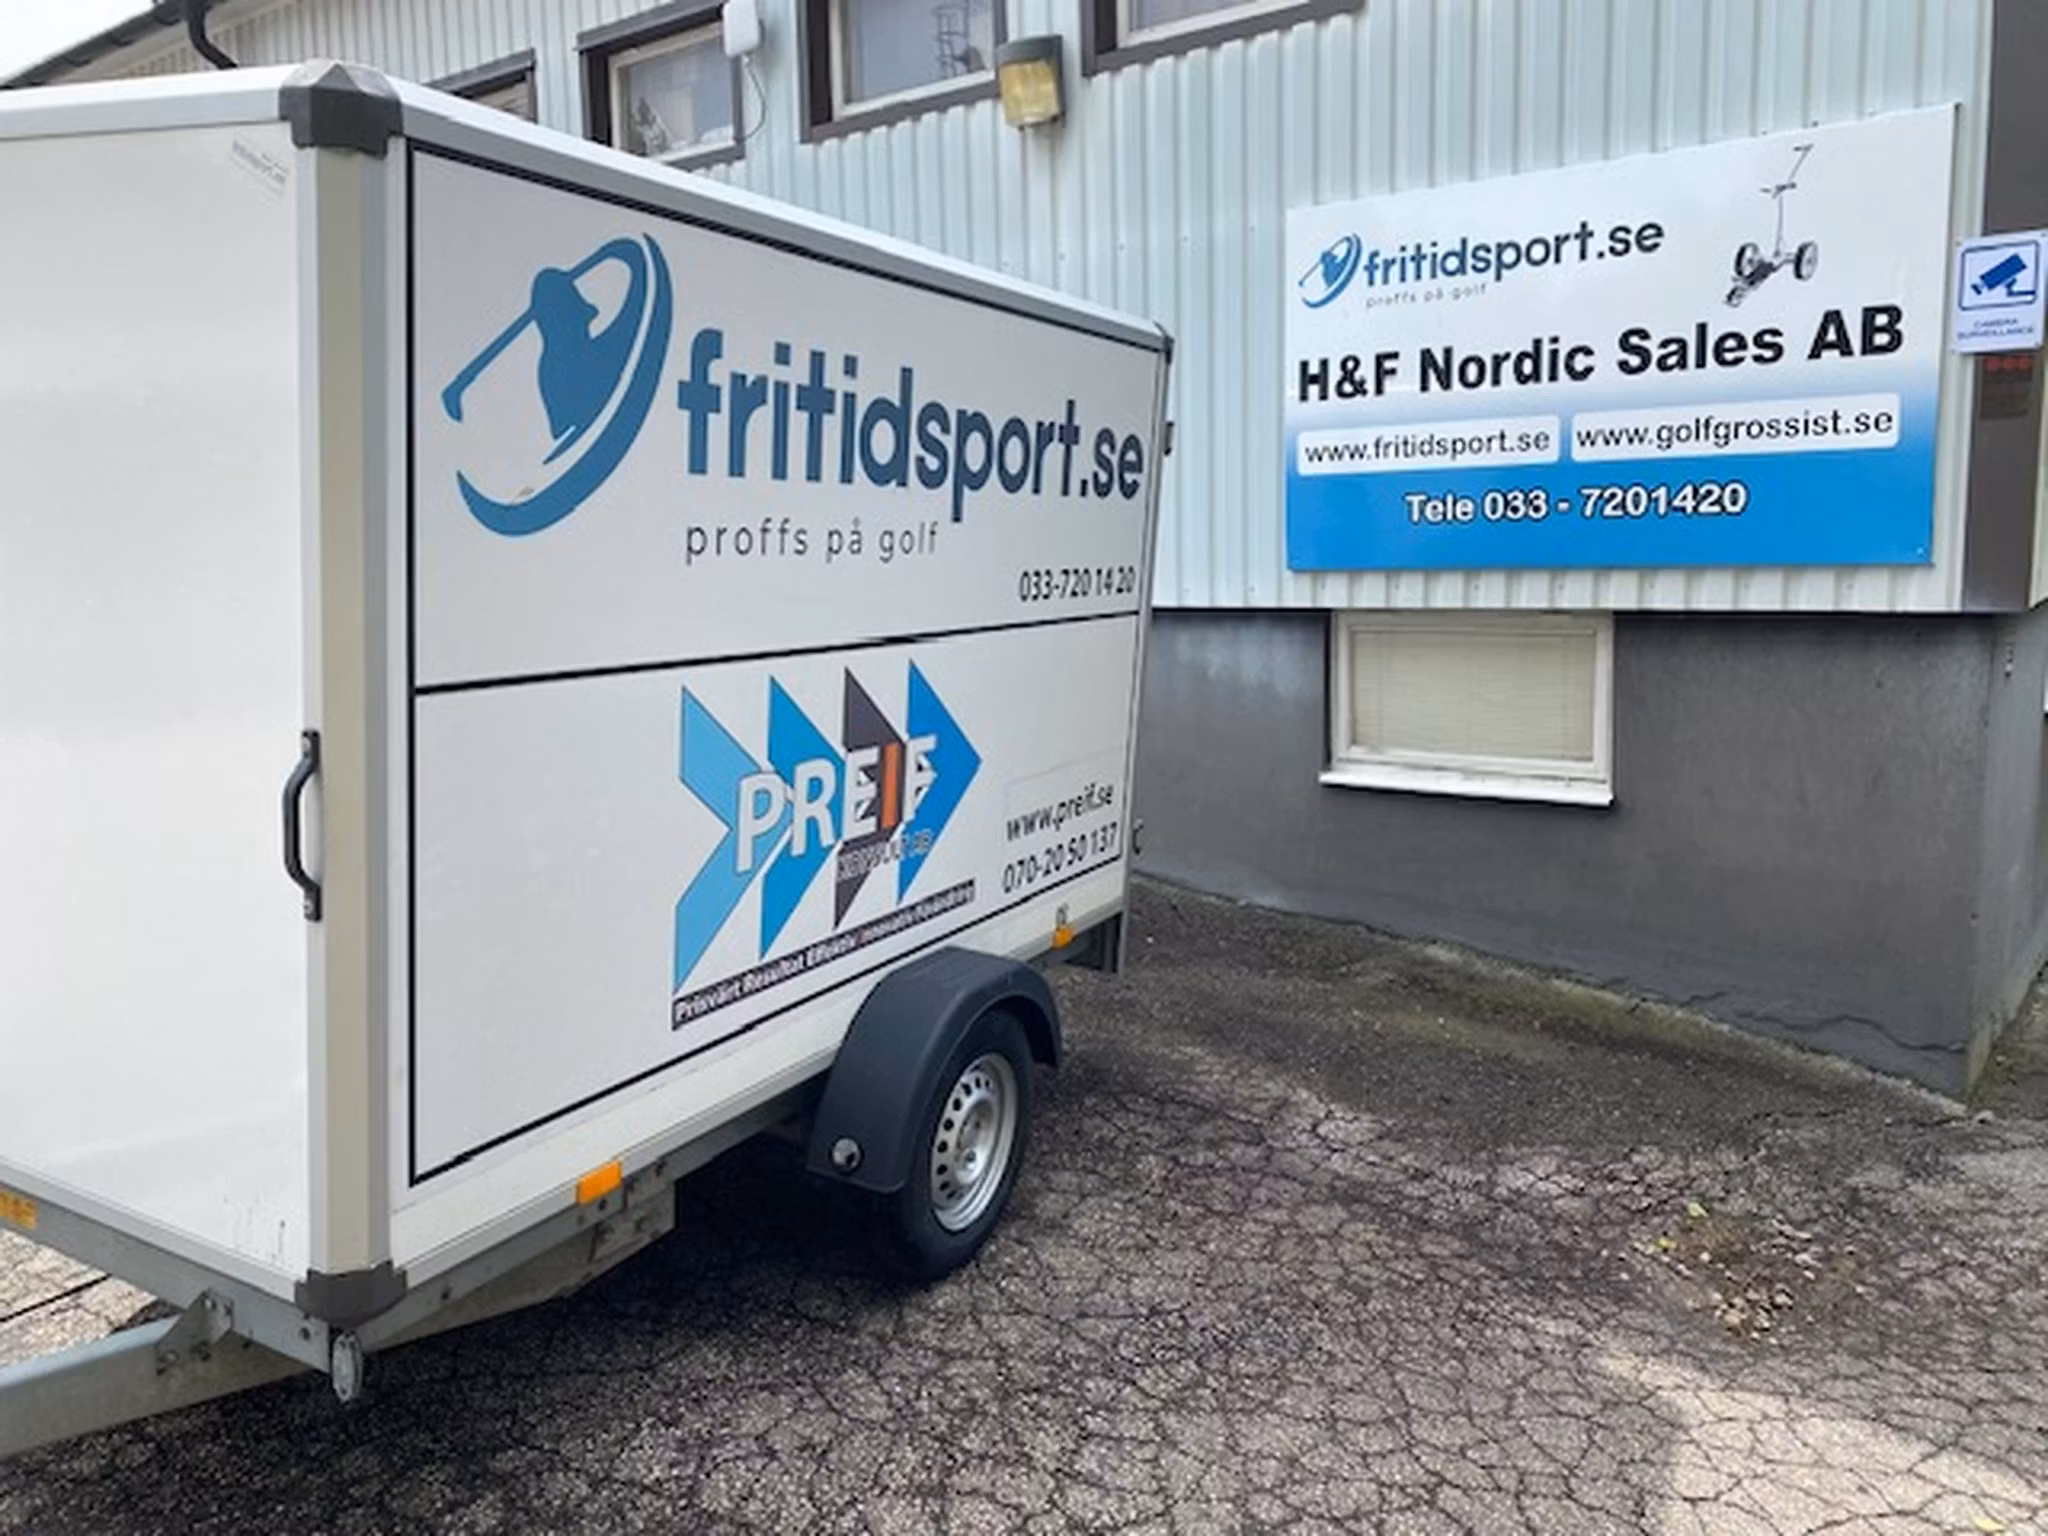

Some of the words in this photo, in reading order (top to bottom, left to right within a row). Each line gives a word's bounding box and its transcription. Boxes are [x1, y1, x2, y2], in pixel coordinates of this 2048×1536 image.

[1363, 221, 1665, 286] fritidsport.se
[1298, 351, 1400, 403] H&F
[1419, 336, 1596, 394] Nordic
[1617, 321, 1784, 376] Sales
[1807, 304, 1904, 361] AB
[677, 327, 1145, 523] fritidsport.se
[1304, 430, 1551, 465] www.fritidsport.se
[1576, 408, 1894, 451] www.golfgrossist.se
[1404, 492, 1475, 524] Tele
[1483, 489, 1549, 521] 033
[1579, 481, 1749, 520] 7201420
[686, 516, 808, 567] proffs
[824, 516, 863, 564] på
[879, 520, 939, 564] golf
[1018, 567, 1093, 601] 033-720
[736, 733, 939, 874] PREIF
[1005, 780, 1115, 842] www.preif.se
